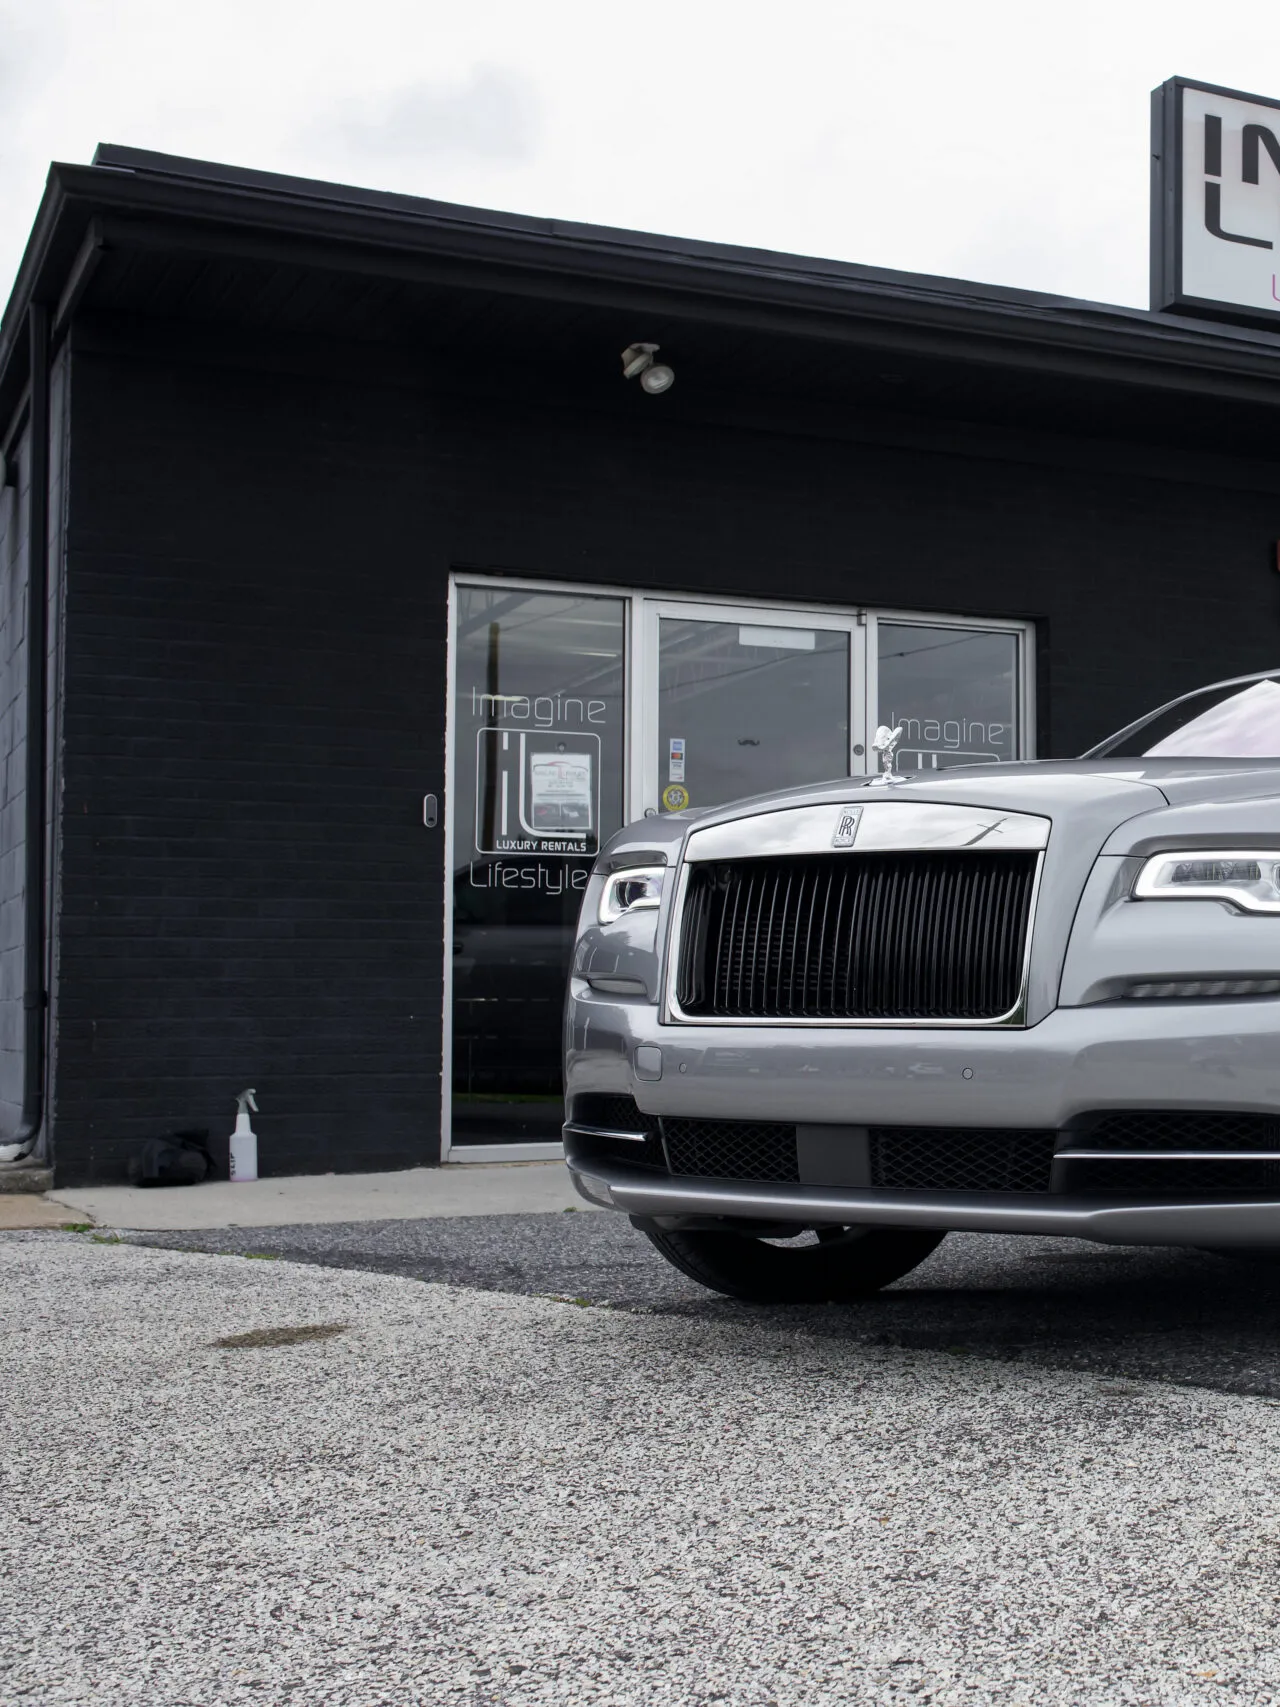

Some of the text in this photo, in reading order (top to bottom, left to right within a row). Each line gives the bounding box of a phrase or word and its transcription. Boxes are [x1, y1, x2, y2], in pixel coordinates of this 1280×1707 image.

[472, 686, 606, 727] Imagine
[496, 839, 587, 852] LUXURY RENTALS
[470, 861, 588, 895] Lifestyle
